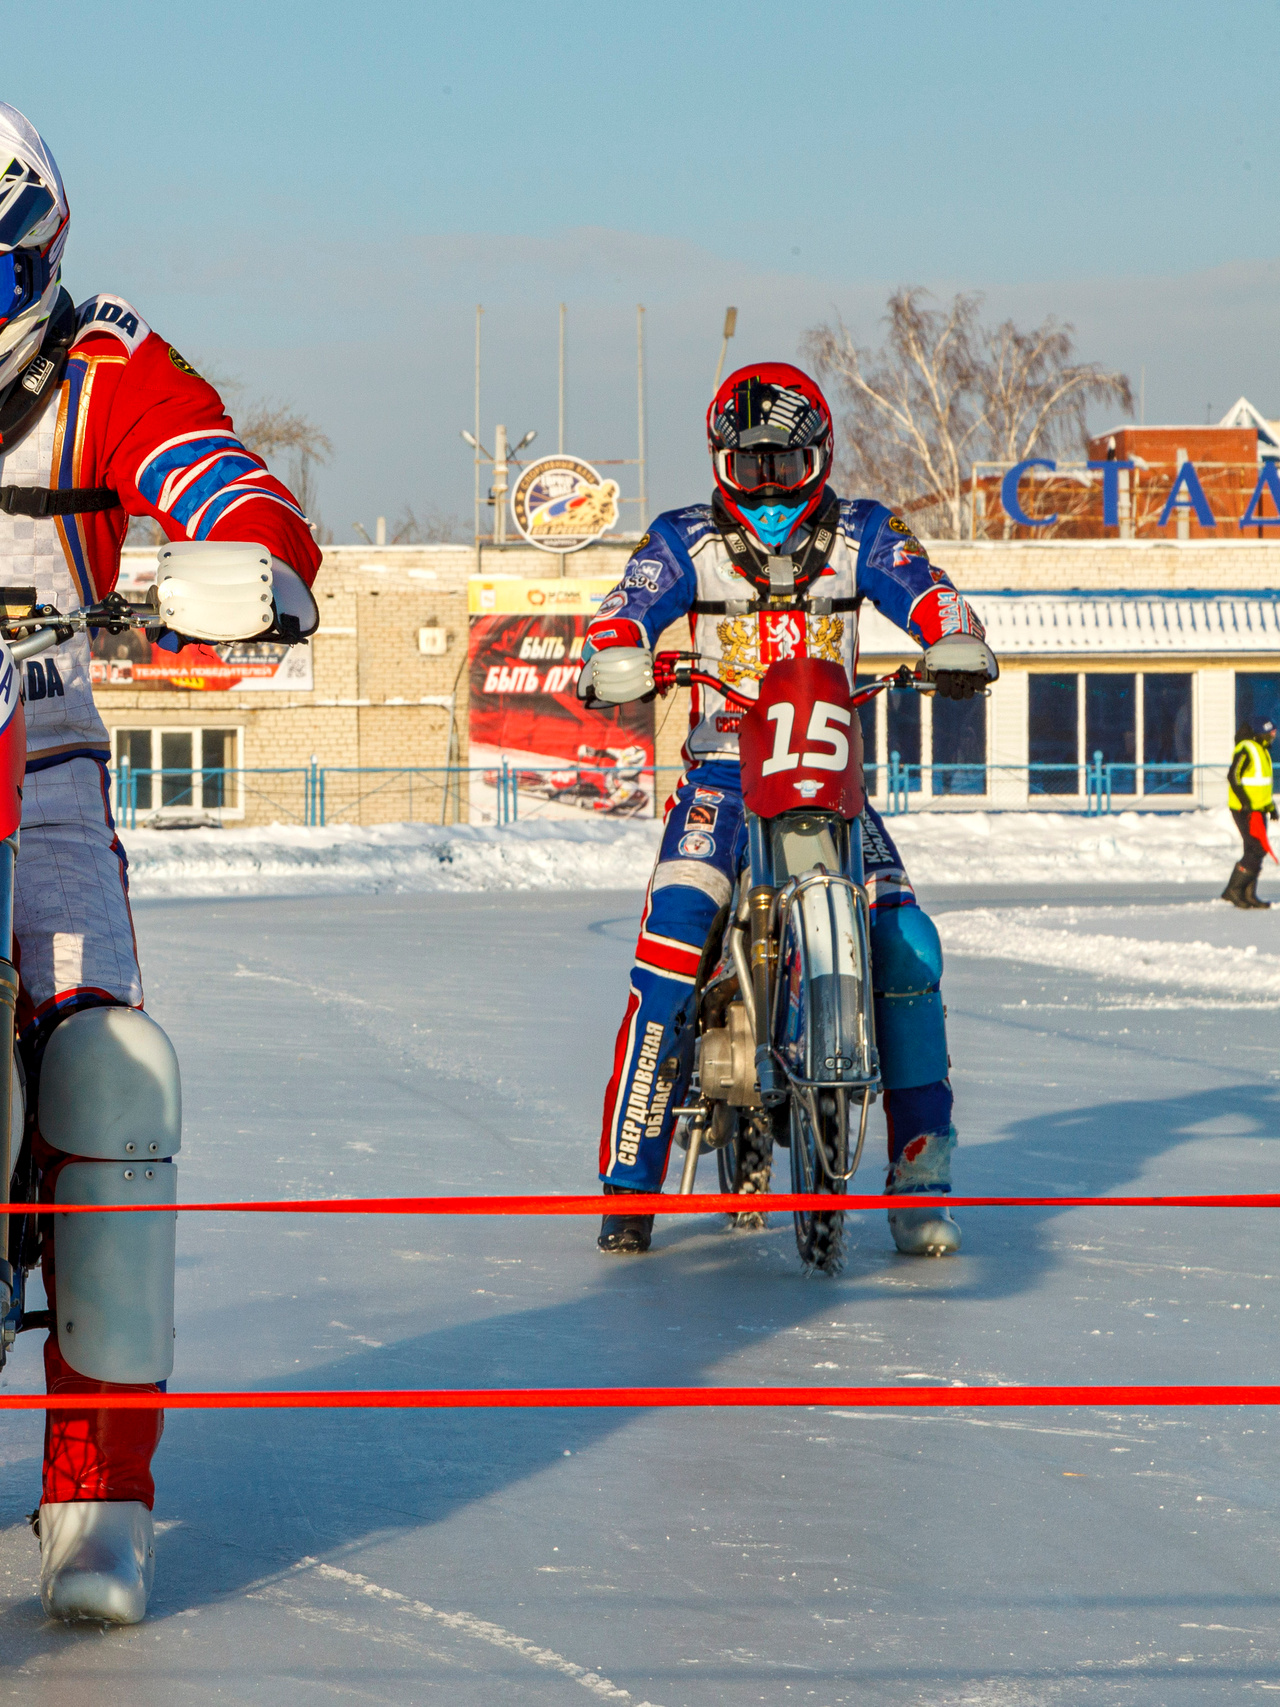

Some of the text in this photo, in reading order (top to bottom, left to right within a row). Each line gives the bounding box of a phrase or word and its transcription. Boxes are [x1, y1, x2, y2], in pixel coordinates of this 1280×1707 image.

[76, 301, 139, 339] ADA
[1001, 458, 1280, 529] СТАД
[519, 637, 566, 660] БЫТЬ
[22, 658, 65, 702] DA
[136, 667, 188, 677] ТЕХНИКА
[190, 666, 273, 677] ПОБЕДИТЕЛЕЙ
[483, 665, 540, 694] БЫТЬ
[761, 700, 852, 778] 15
[618, 1021, 665, 1167] СВЕРДЛОВСКАЯ
